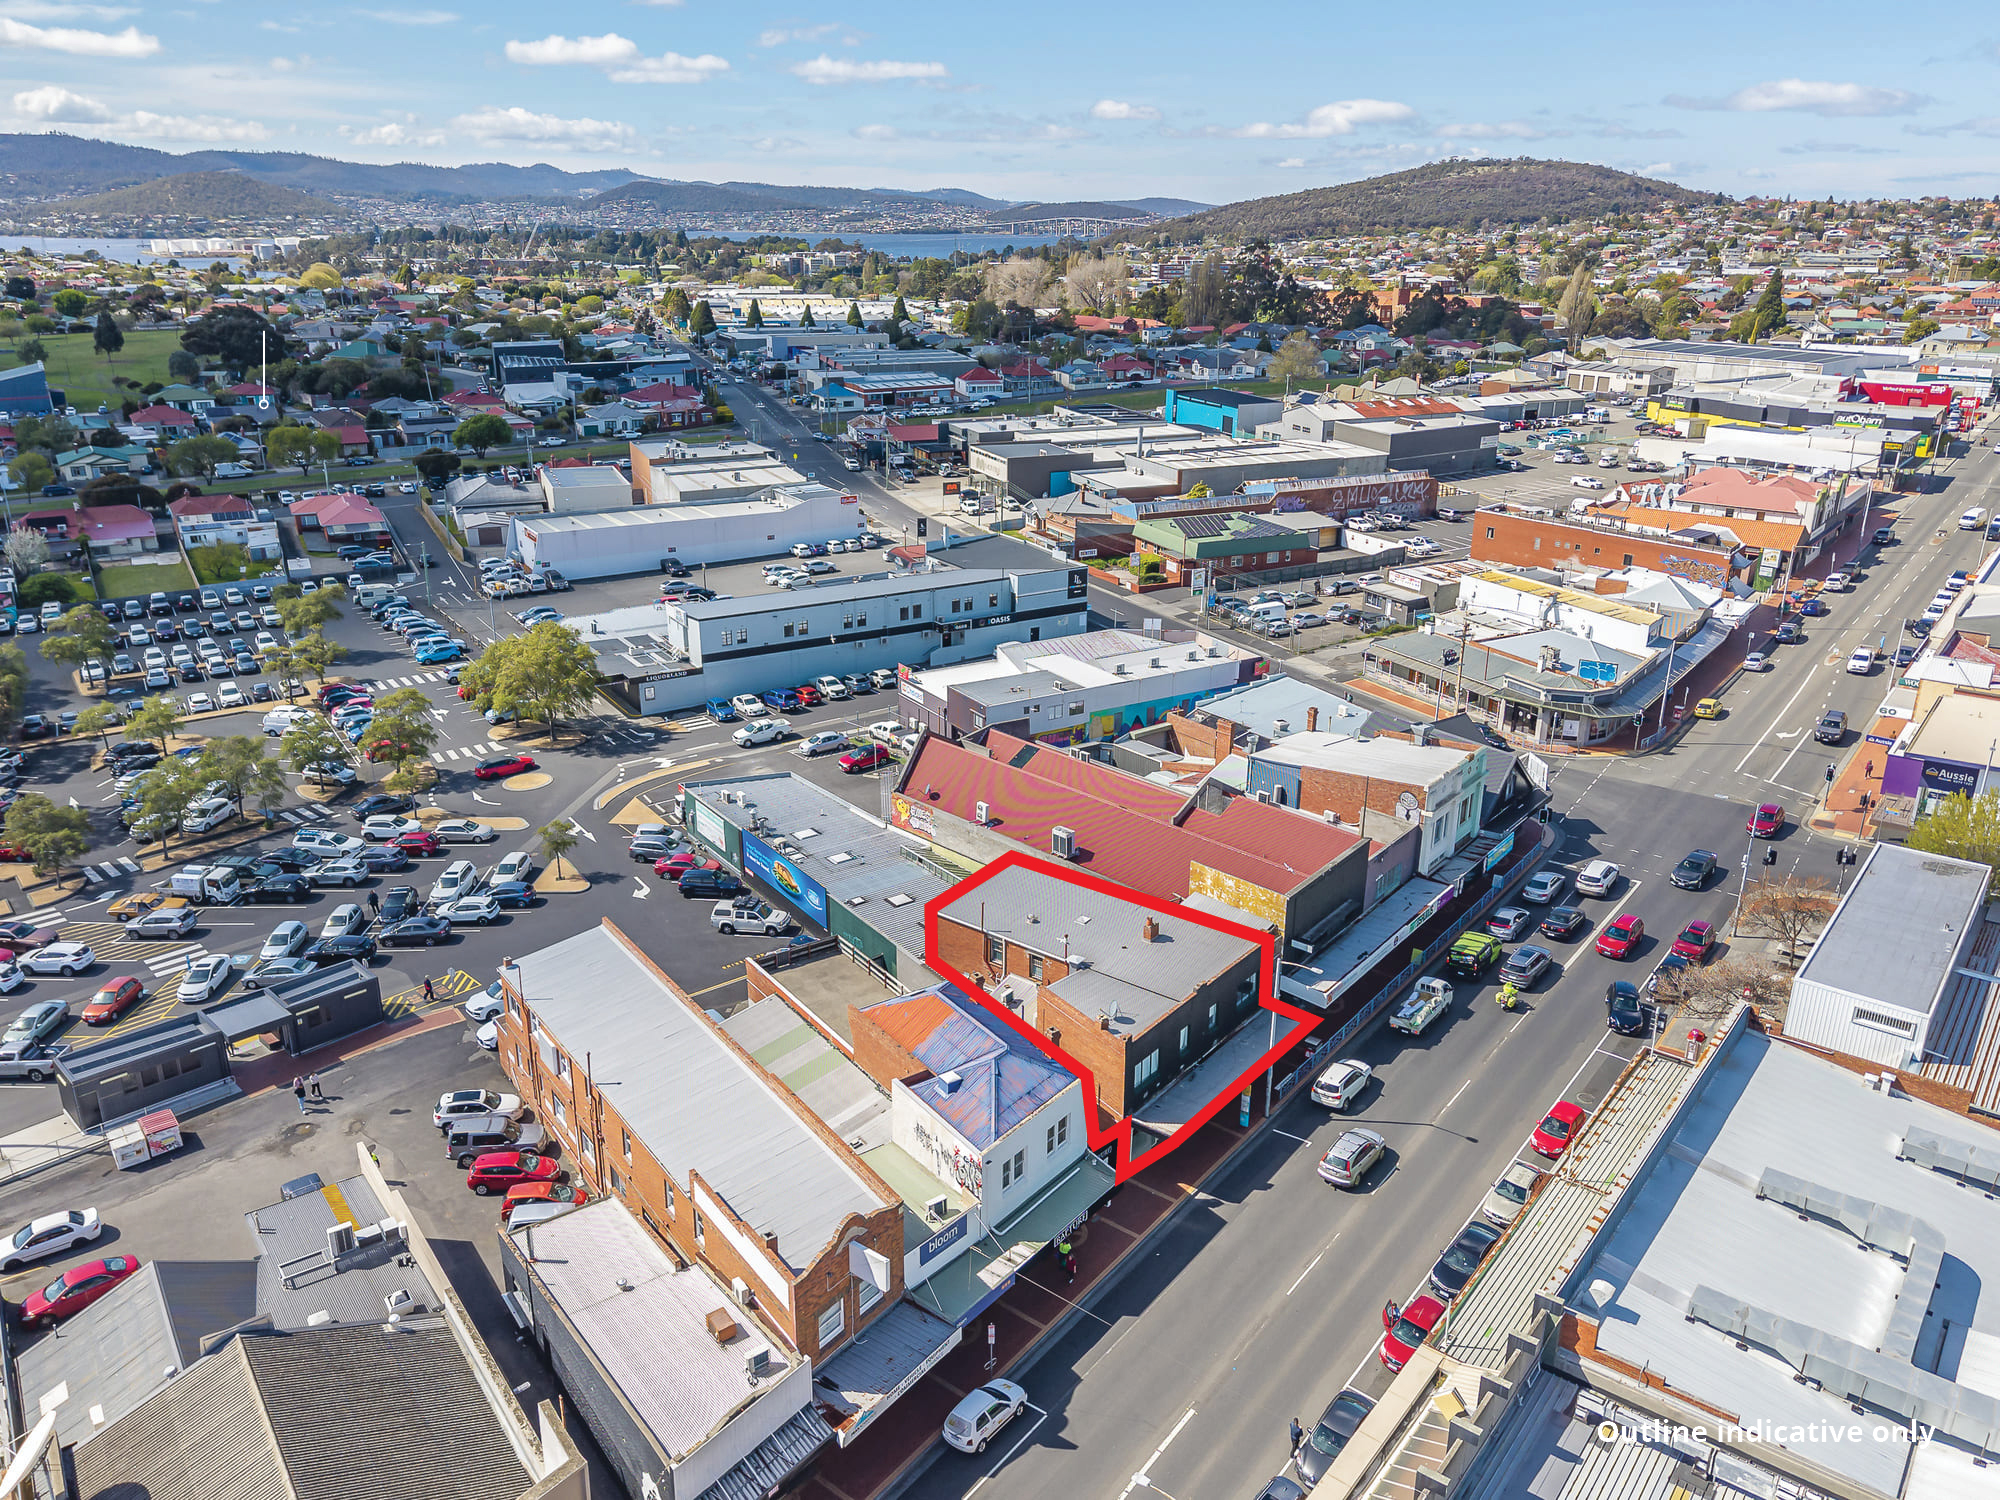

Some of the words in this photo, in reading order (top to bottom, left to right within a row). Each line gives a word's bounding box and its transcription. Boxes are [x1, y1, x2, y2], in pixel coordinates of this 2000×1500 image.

[1930, 386, 1946, 394] zap
[990, 615, 1011, 624] OASIS
[646, 671, 688, 682] LIQUORLAND
[1879, 707, 1897, 716] 60
[1875, 738, 1893, 746] Aussie
[1938, 768, 1975, 784] Aussie
[928, 1225, 958, 1254] bloom
